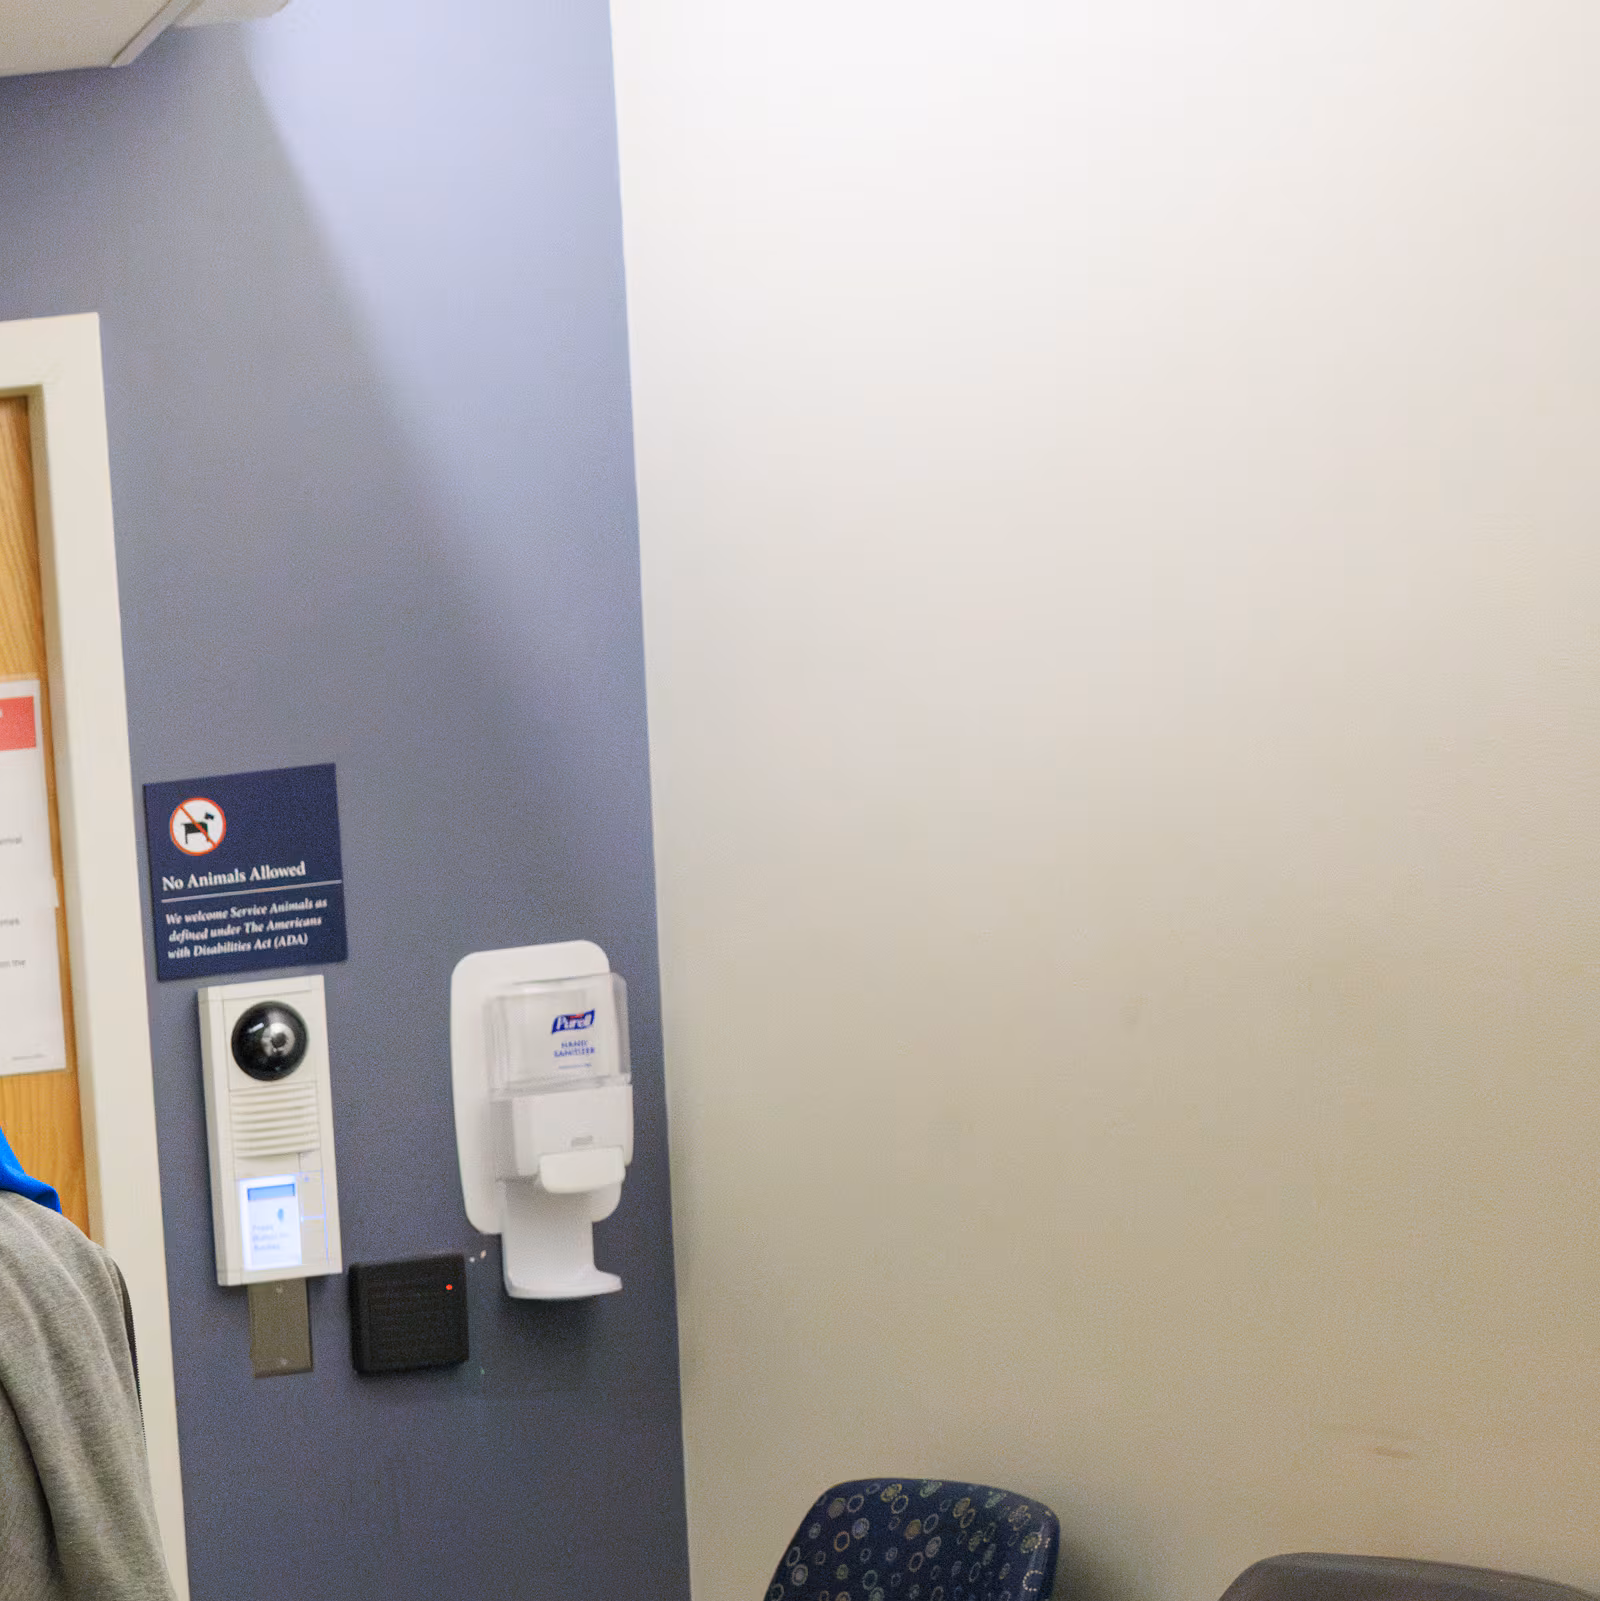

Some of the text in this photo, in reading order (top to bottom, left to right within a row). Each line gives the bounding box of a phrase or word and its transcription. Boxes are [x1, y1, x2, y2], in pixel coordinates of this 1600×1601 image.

[162, 861, 306, 892] No Animals Allowed
[166, 898, 328, 925] We welcome Service Animals as
[168, 916, 323, 944] defined under The Americans
[168, 932, 309, 960] with Disabilities Act (ADA)
[553, 1047, 596, 1058] SANITIZER
